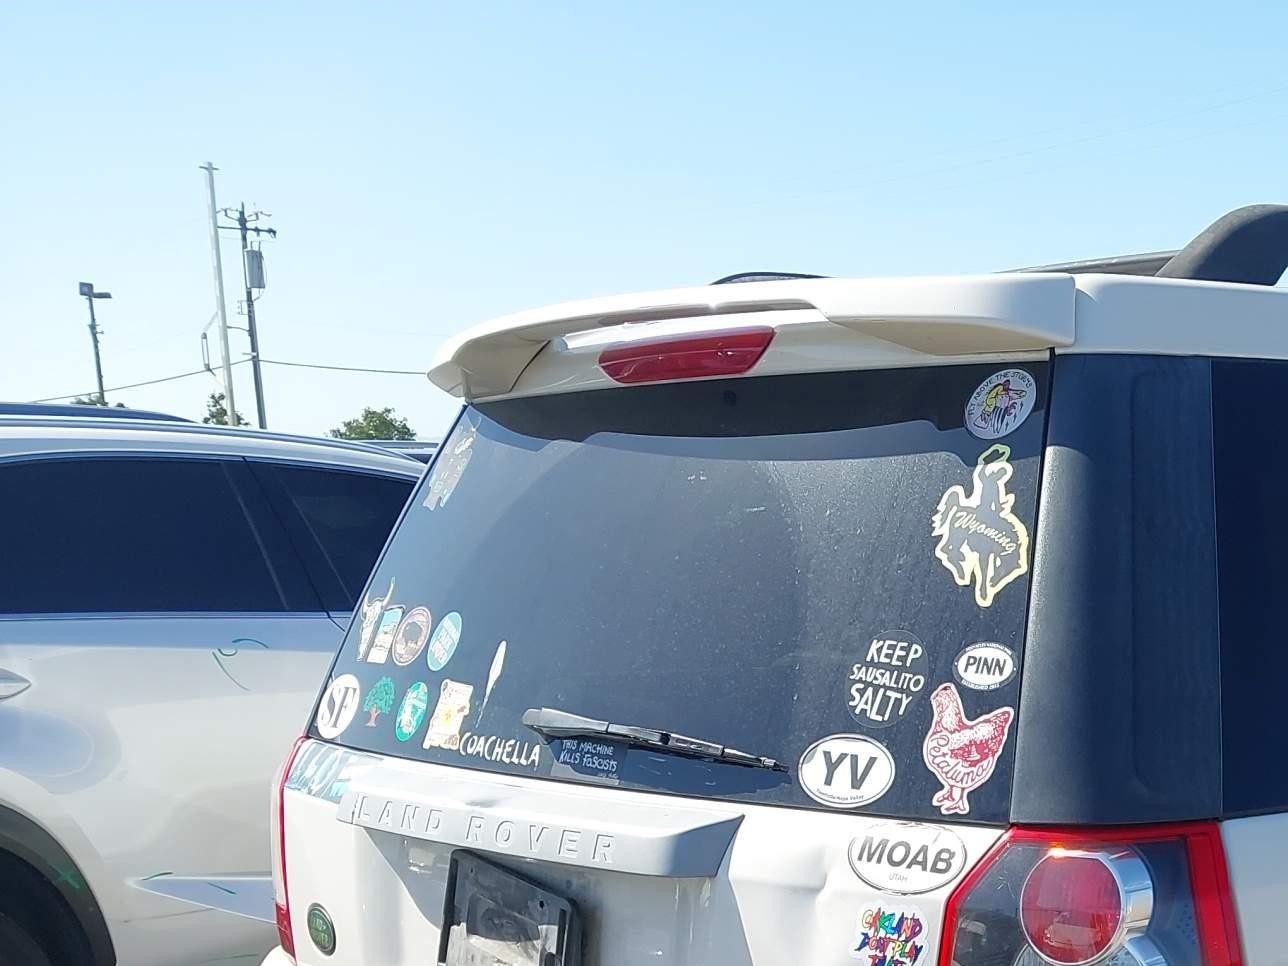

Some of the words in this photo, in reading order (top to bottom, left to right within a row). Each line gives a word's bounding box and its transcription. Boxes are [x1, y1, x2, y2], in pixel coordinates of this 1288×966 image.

[956, 511, 1017, 556] Wyoming
[866, 639, 922, 667] KEEP
[963, 655, 1007, 676] PINN
[849, 664, 925, 692] SAUSALITO
[320, 686, 357, 728] SF
[849, 683, 913, 722] SALTY
[460, 732, 541, 767] COACHELLA
[559, 750, 580, 764] KILLS
[579, 742, 614, 756] MACHINE
[822, 750, 878, 790] YV
[356, 795, 450, 834] LAND
[463, 827, 619, 864] ROVER
[857, 836, 956, 874] MOAB
